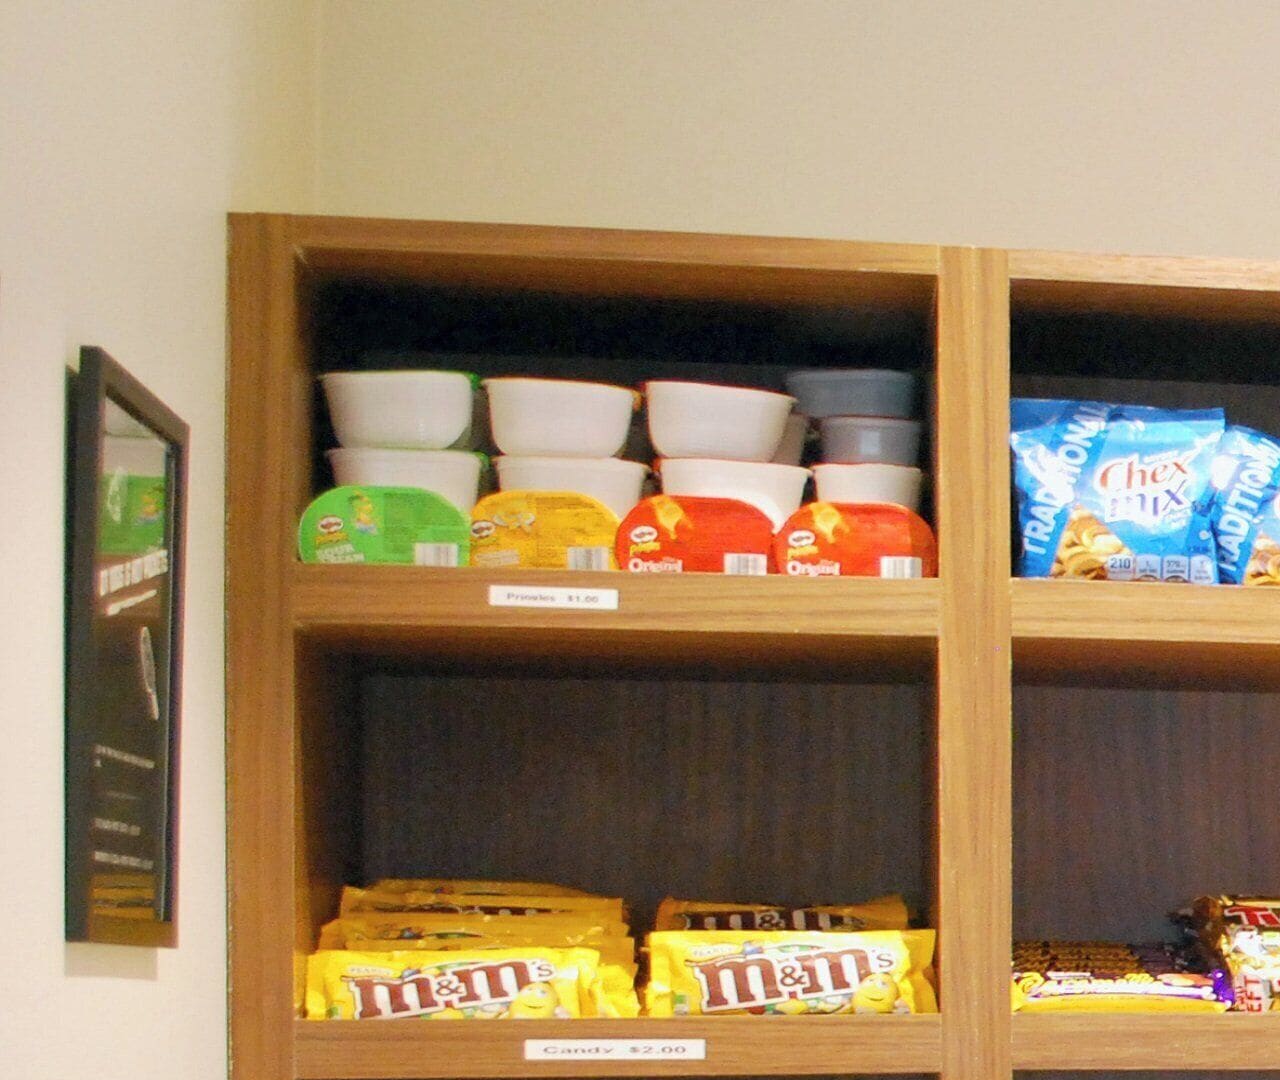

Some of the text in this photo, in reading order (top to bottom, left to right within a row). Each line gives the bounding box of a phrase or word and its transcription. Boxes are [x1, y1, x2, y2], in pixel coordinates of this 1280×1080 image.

[1099, 457, 1190, 493] Chex
[627, 556, 683, 574] Original
[786, 560, 841, 577] Original
[566, 593, 599, 604] $1.00
[695, 949, 894, 1007] m&m's
[352, 959, 555, 1019] m&m's
[542, 1045, 687, 1056] Candy $2.00
